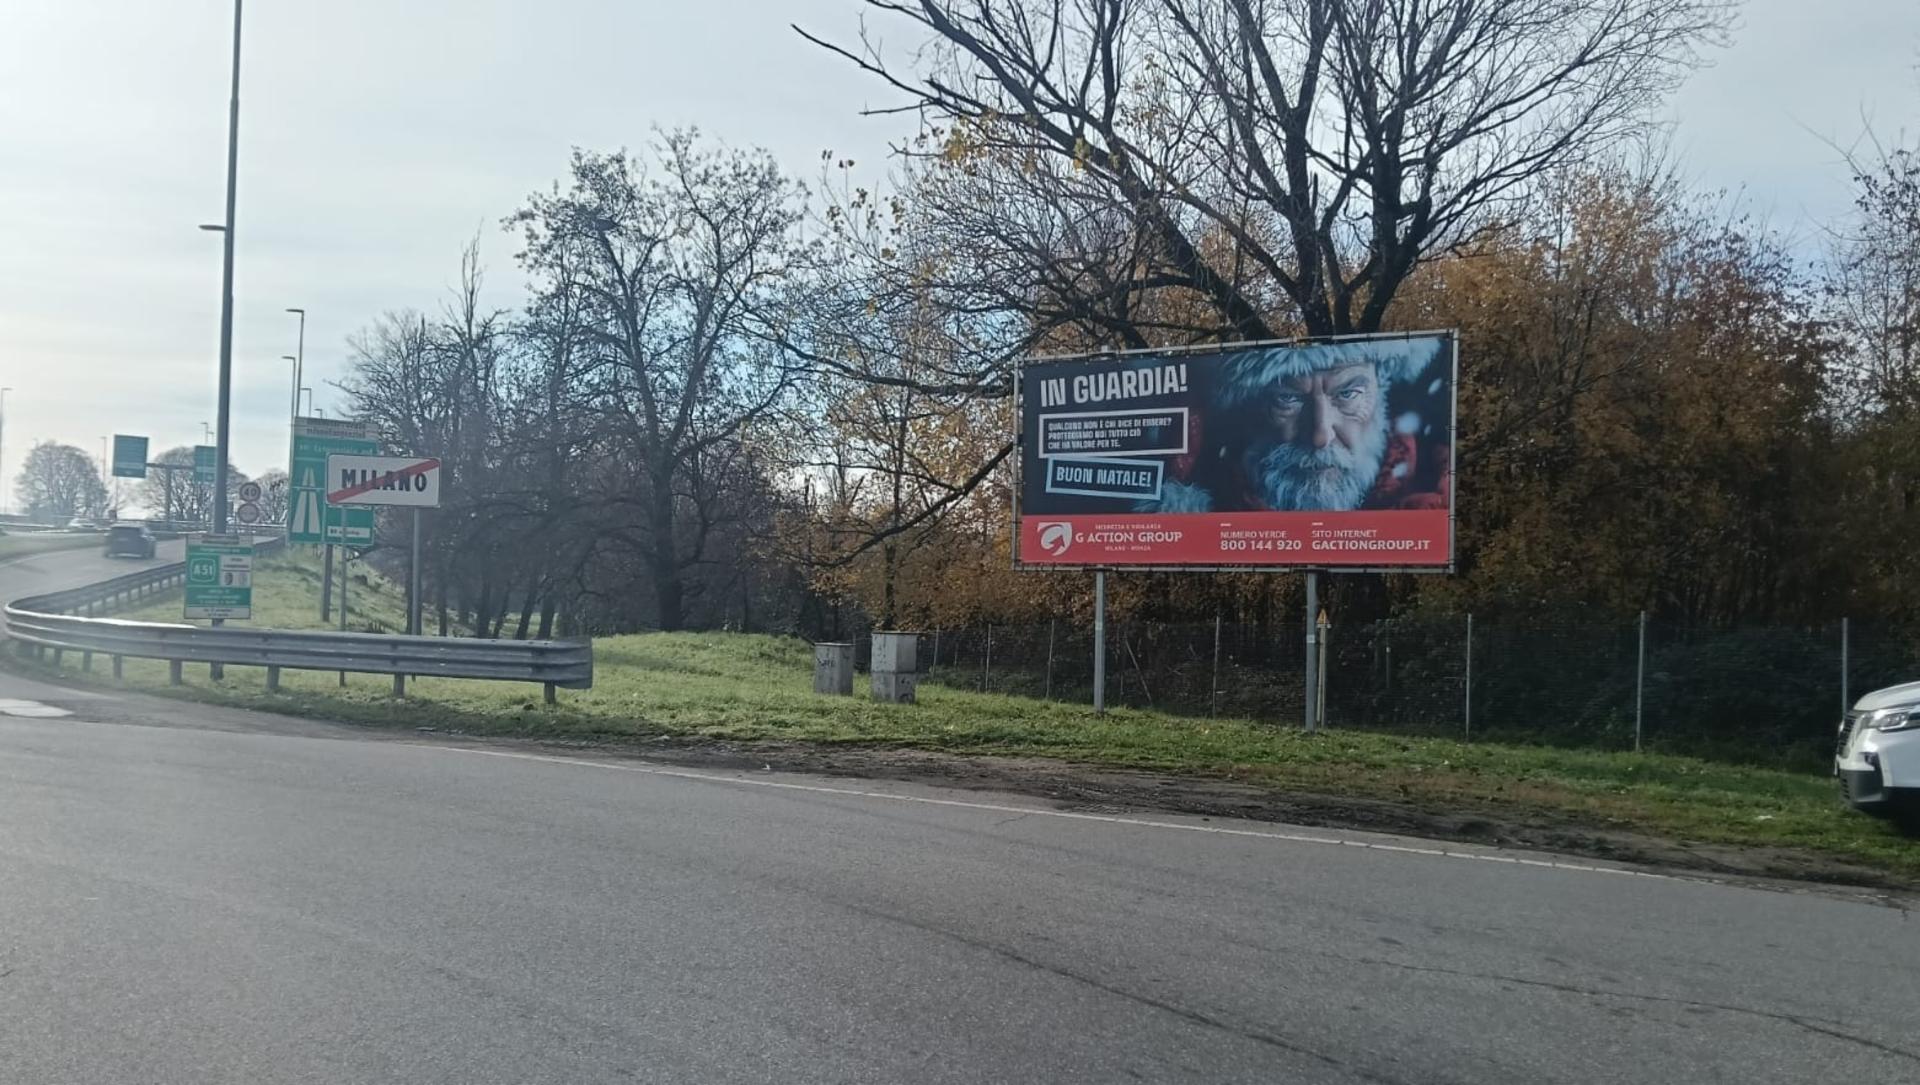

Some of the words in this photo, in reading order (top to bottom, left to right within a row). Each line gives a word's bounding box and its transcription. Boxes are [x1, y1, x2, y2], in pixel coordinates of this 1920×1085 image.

[1040, 378, 1067, 407] IN
[1073, 363, 1188, 404] GUARDIA!
[341, 468, 428, 492] MILANO
[1056, 465, 1093, 484] BUON
[1096, 468, 1152, 488] NATALE!
[1075, 532, 1084, 543] G
[1087, 531, 1134, 543] ACTION
[1138, 531, 1183, 543] GROUP
[1220, 530, 1257, 539] NUMERO
[1258, 530, 1288, 539] VERDE
[1312, 530, 1332, 538] SITO
[1334, 529, 1377, 538] INTERNET
[1220, 539, 1247, 550] 800
[1250, 539, 1273, 550] 144
[1276, 539, 1302, 550] 920
[1312, 538, 1431, 550] GACTIONGROUP.IT
[193, 564, 213, 576] A51
